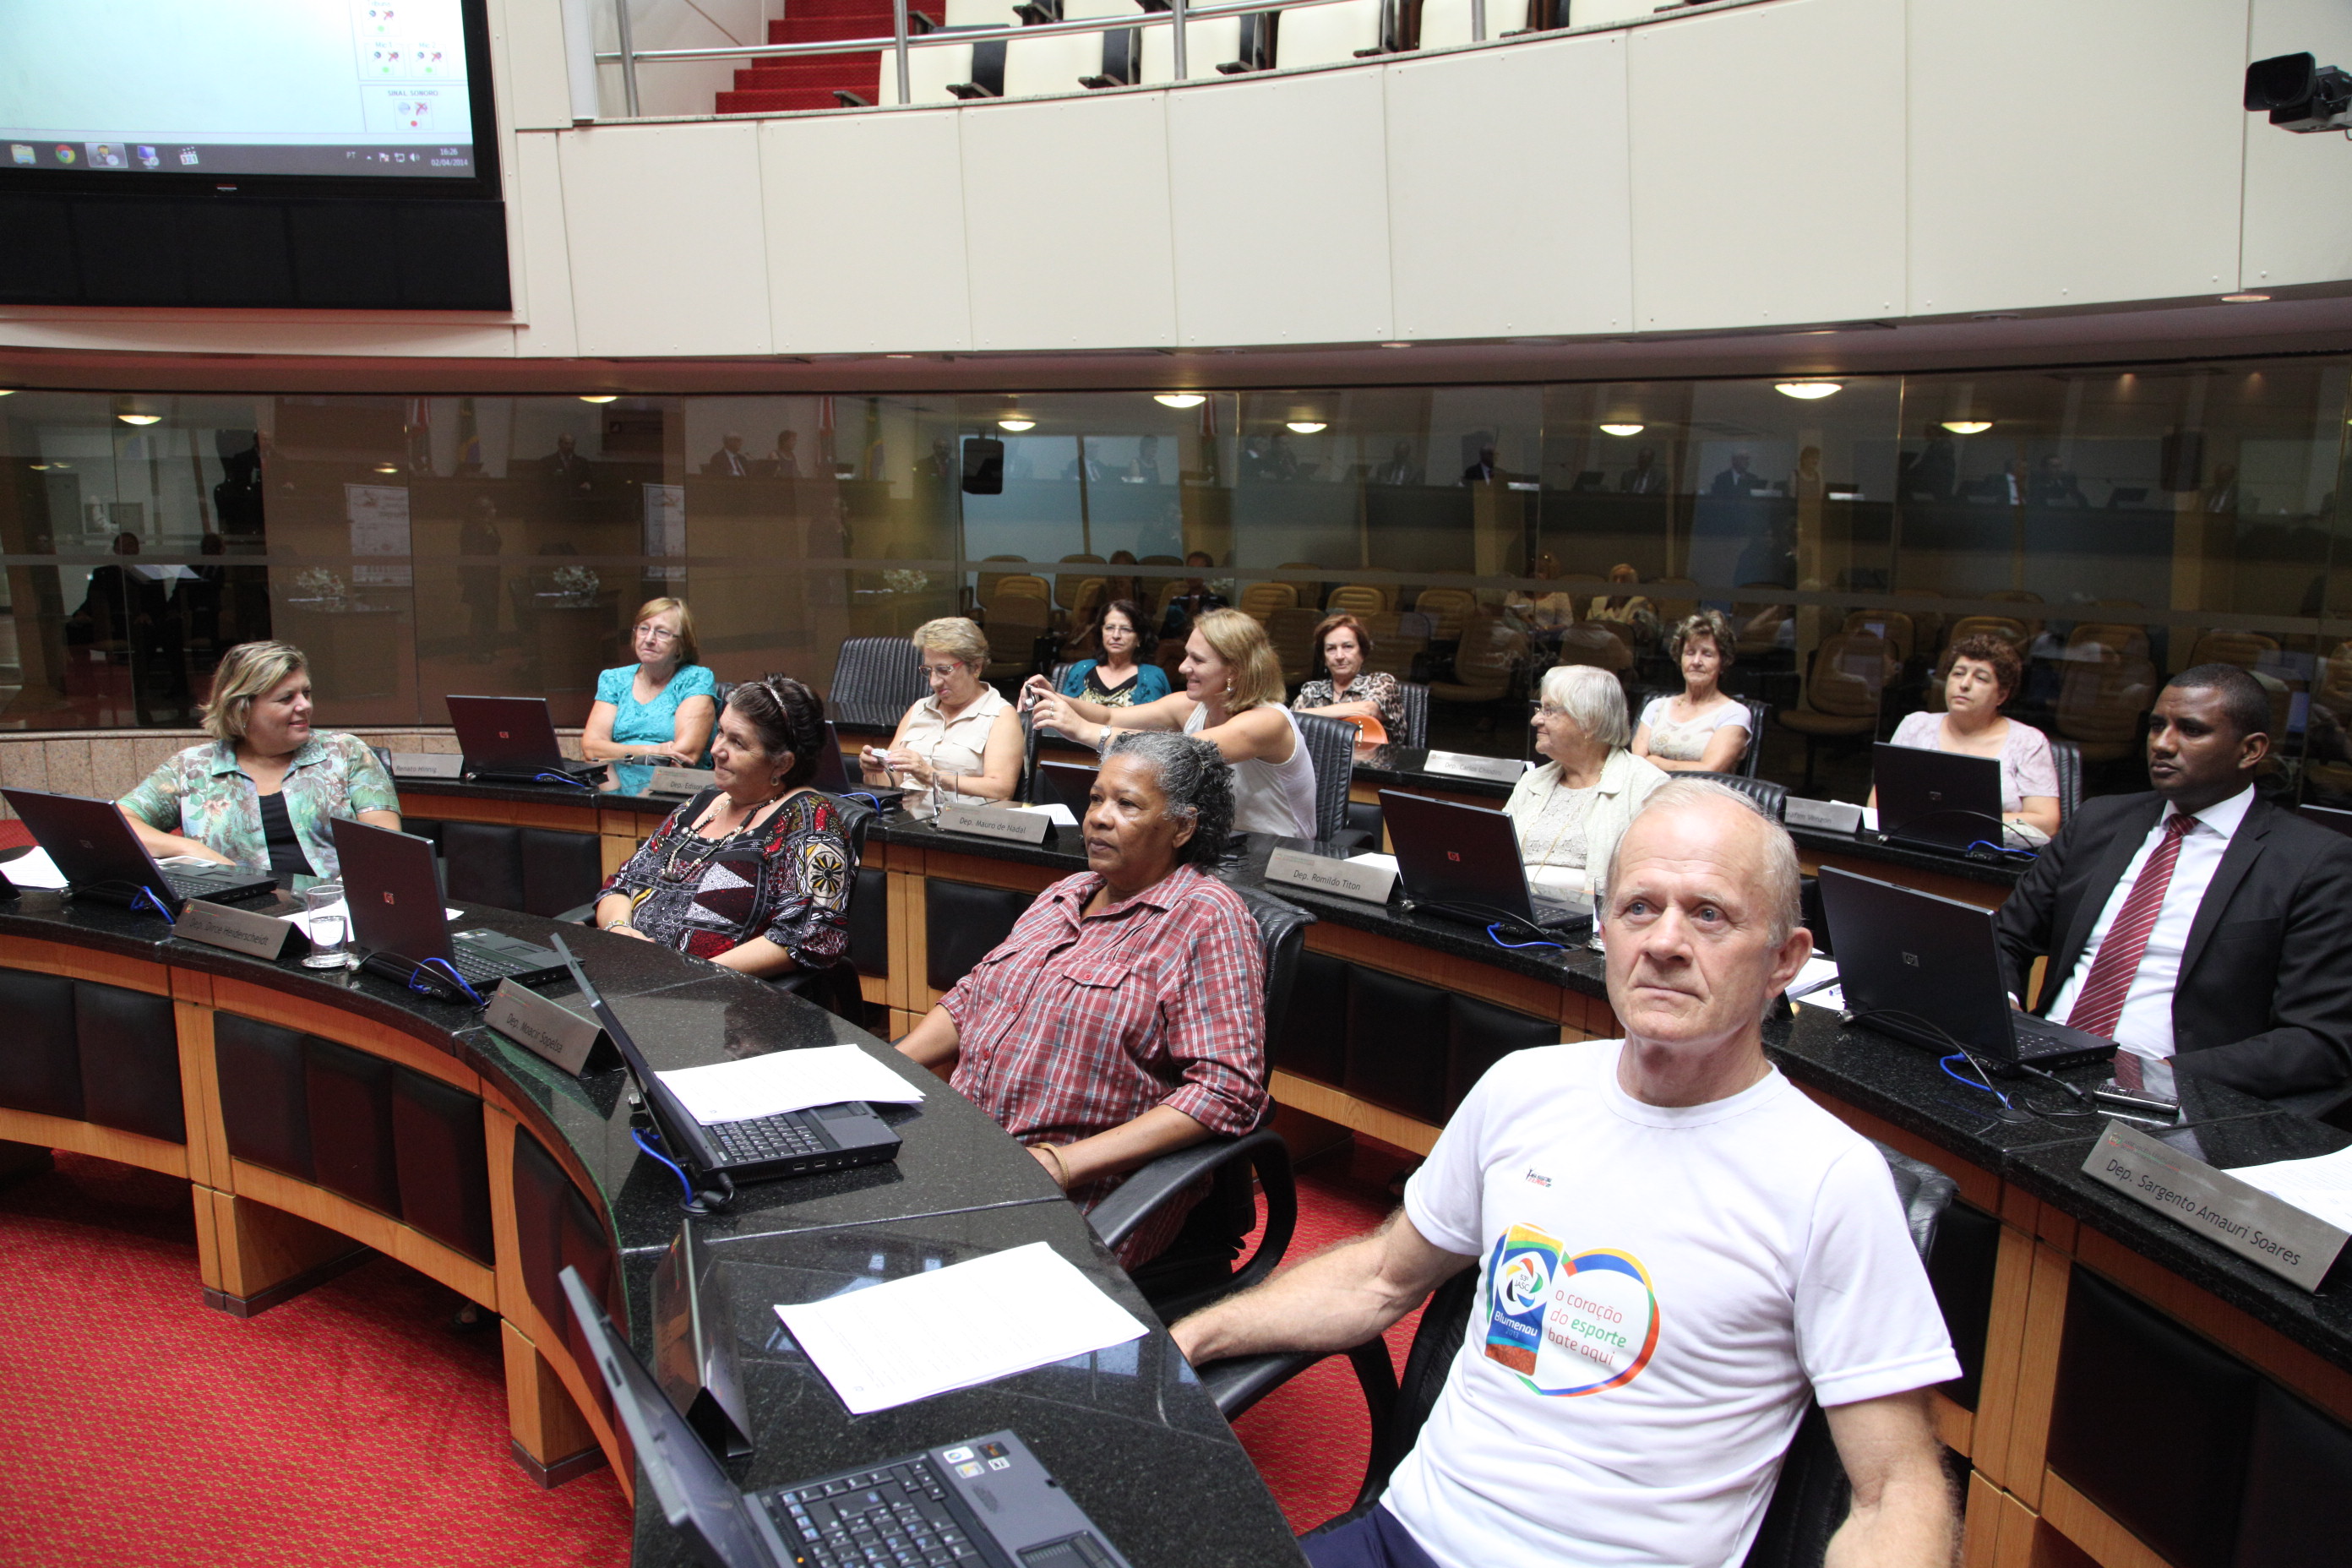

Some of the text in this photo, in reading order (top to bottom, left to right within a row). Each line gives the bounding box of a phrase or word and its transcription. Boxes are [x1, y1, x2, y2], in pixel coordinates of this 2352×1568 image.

[1459, 764, 1478, 772] Carlos
[671, 781, 683, 789] Dep.
[959, 817, 973, 826] Dep.
[975, 820, 996, 829] Mauro
[1007, 825, 1026, 834] Nadal
[1293, 869, 1361, 890] Dep. Romildo Titon
[189, 917, 269, 945] Dep. Dirce Heiderscheidt
[507, 1013, 564, 1054] Dep. Moacir Sopelsa
[2106, 1158, 2133, 1182] Dep.
[2137, 1173, 2197, 1212] Sargento
[2196, 1206, 2251, 1239] Amauri
[2250, 1230, 2301, 1266] Soares
[1515, 1280, 1530, 1292] JASC
[1555, 1290, 1623, 1324] o coração
[1494, 1310, 1538, 1337] Blumenau
[1505, 1327, 1520, 1339] 2013
[1550, 1308, 1627, 1348] do esporte
[1548, 1326, 1615, 1366] bate aqui
